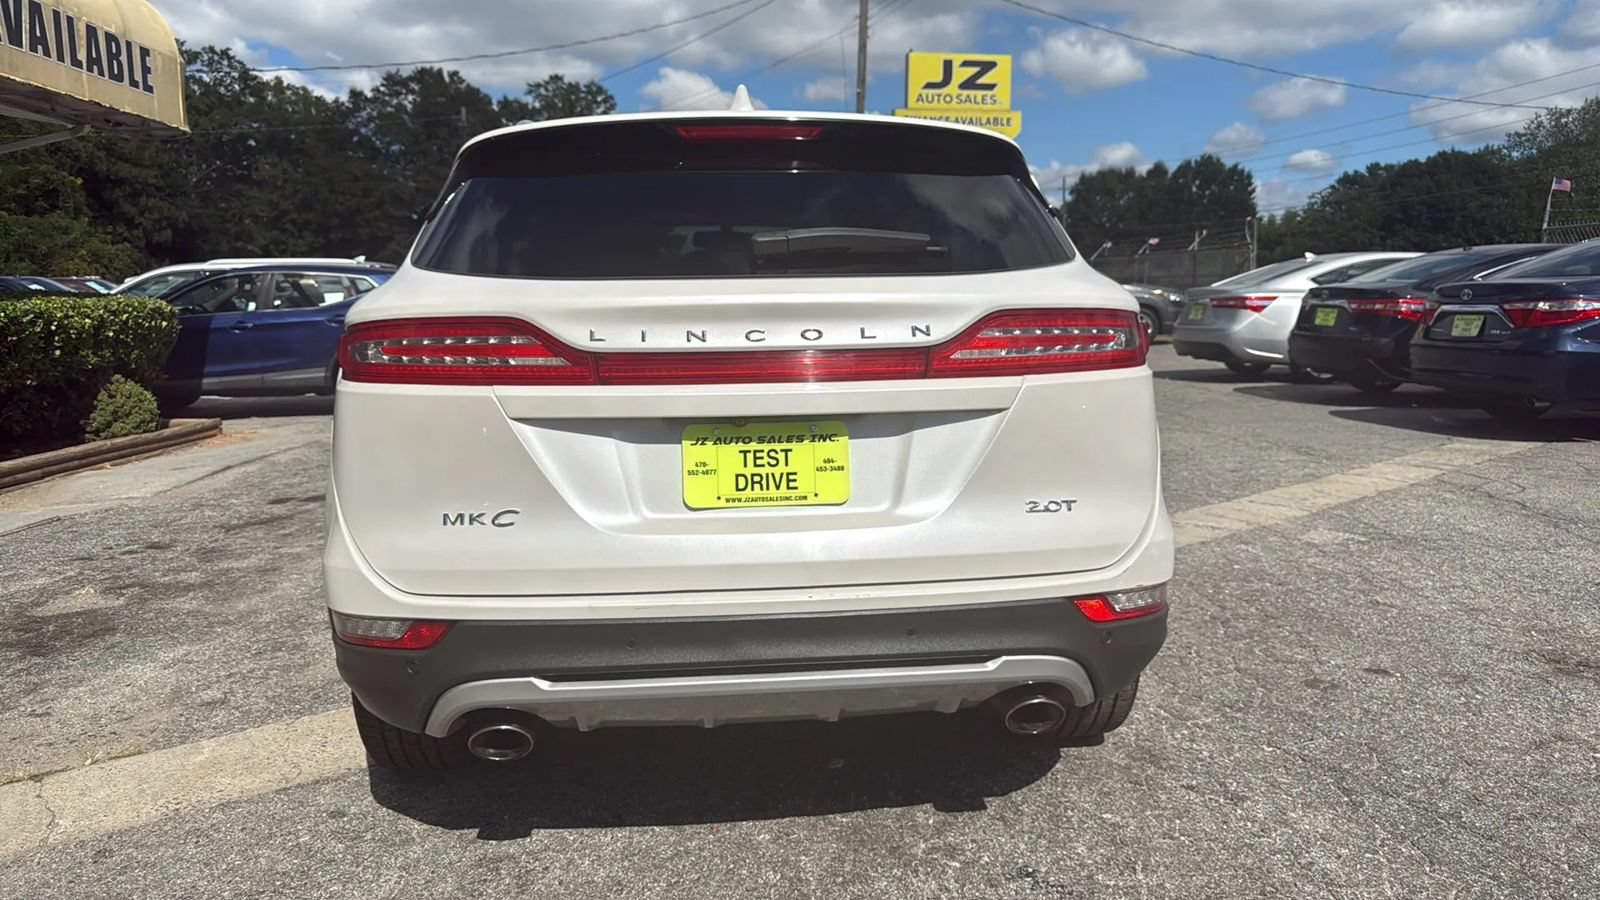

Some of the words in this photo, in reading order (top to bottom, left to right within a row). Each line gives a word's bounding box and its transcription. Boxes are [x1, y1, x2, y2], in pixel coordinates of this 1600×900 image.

[0, 0, 154, 95] VAILABLE
[921, 59, 998, 91] JZ
[915, 93, 953, 105] AUTO
[955, 93, 998, 106] SALES
[952, 116, 1012, 127] AVAILABLE
[589, 325, 931, 342] LINCOLN
[690, 437, 710, 446] JZ
[712, 436, 752, 446] AUTO
[756, 435, 805, 444] SALES
[808, 433, 840, 443] INC.
[739, 449, 793, 468] TEST
[735, 472, 799, 492] DRIVE
[724, 495, 808, 503] WWW.JZAUTOSALESINC.COM
[442, 509, 521, 527] MKC
